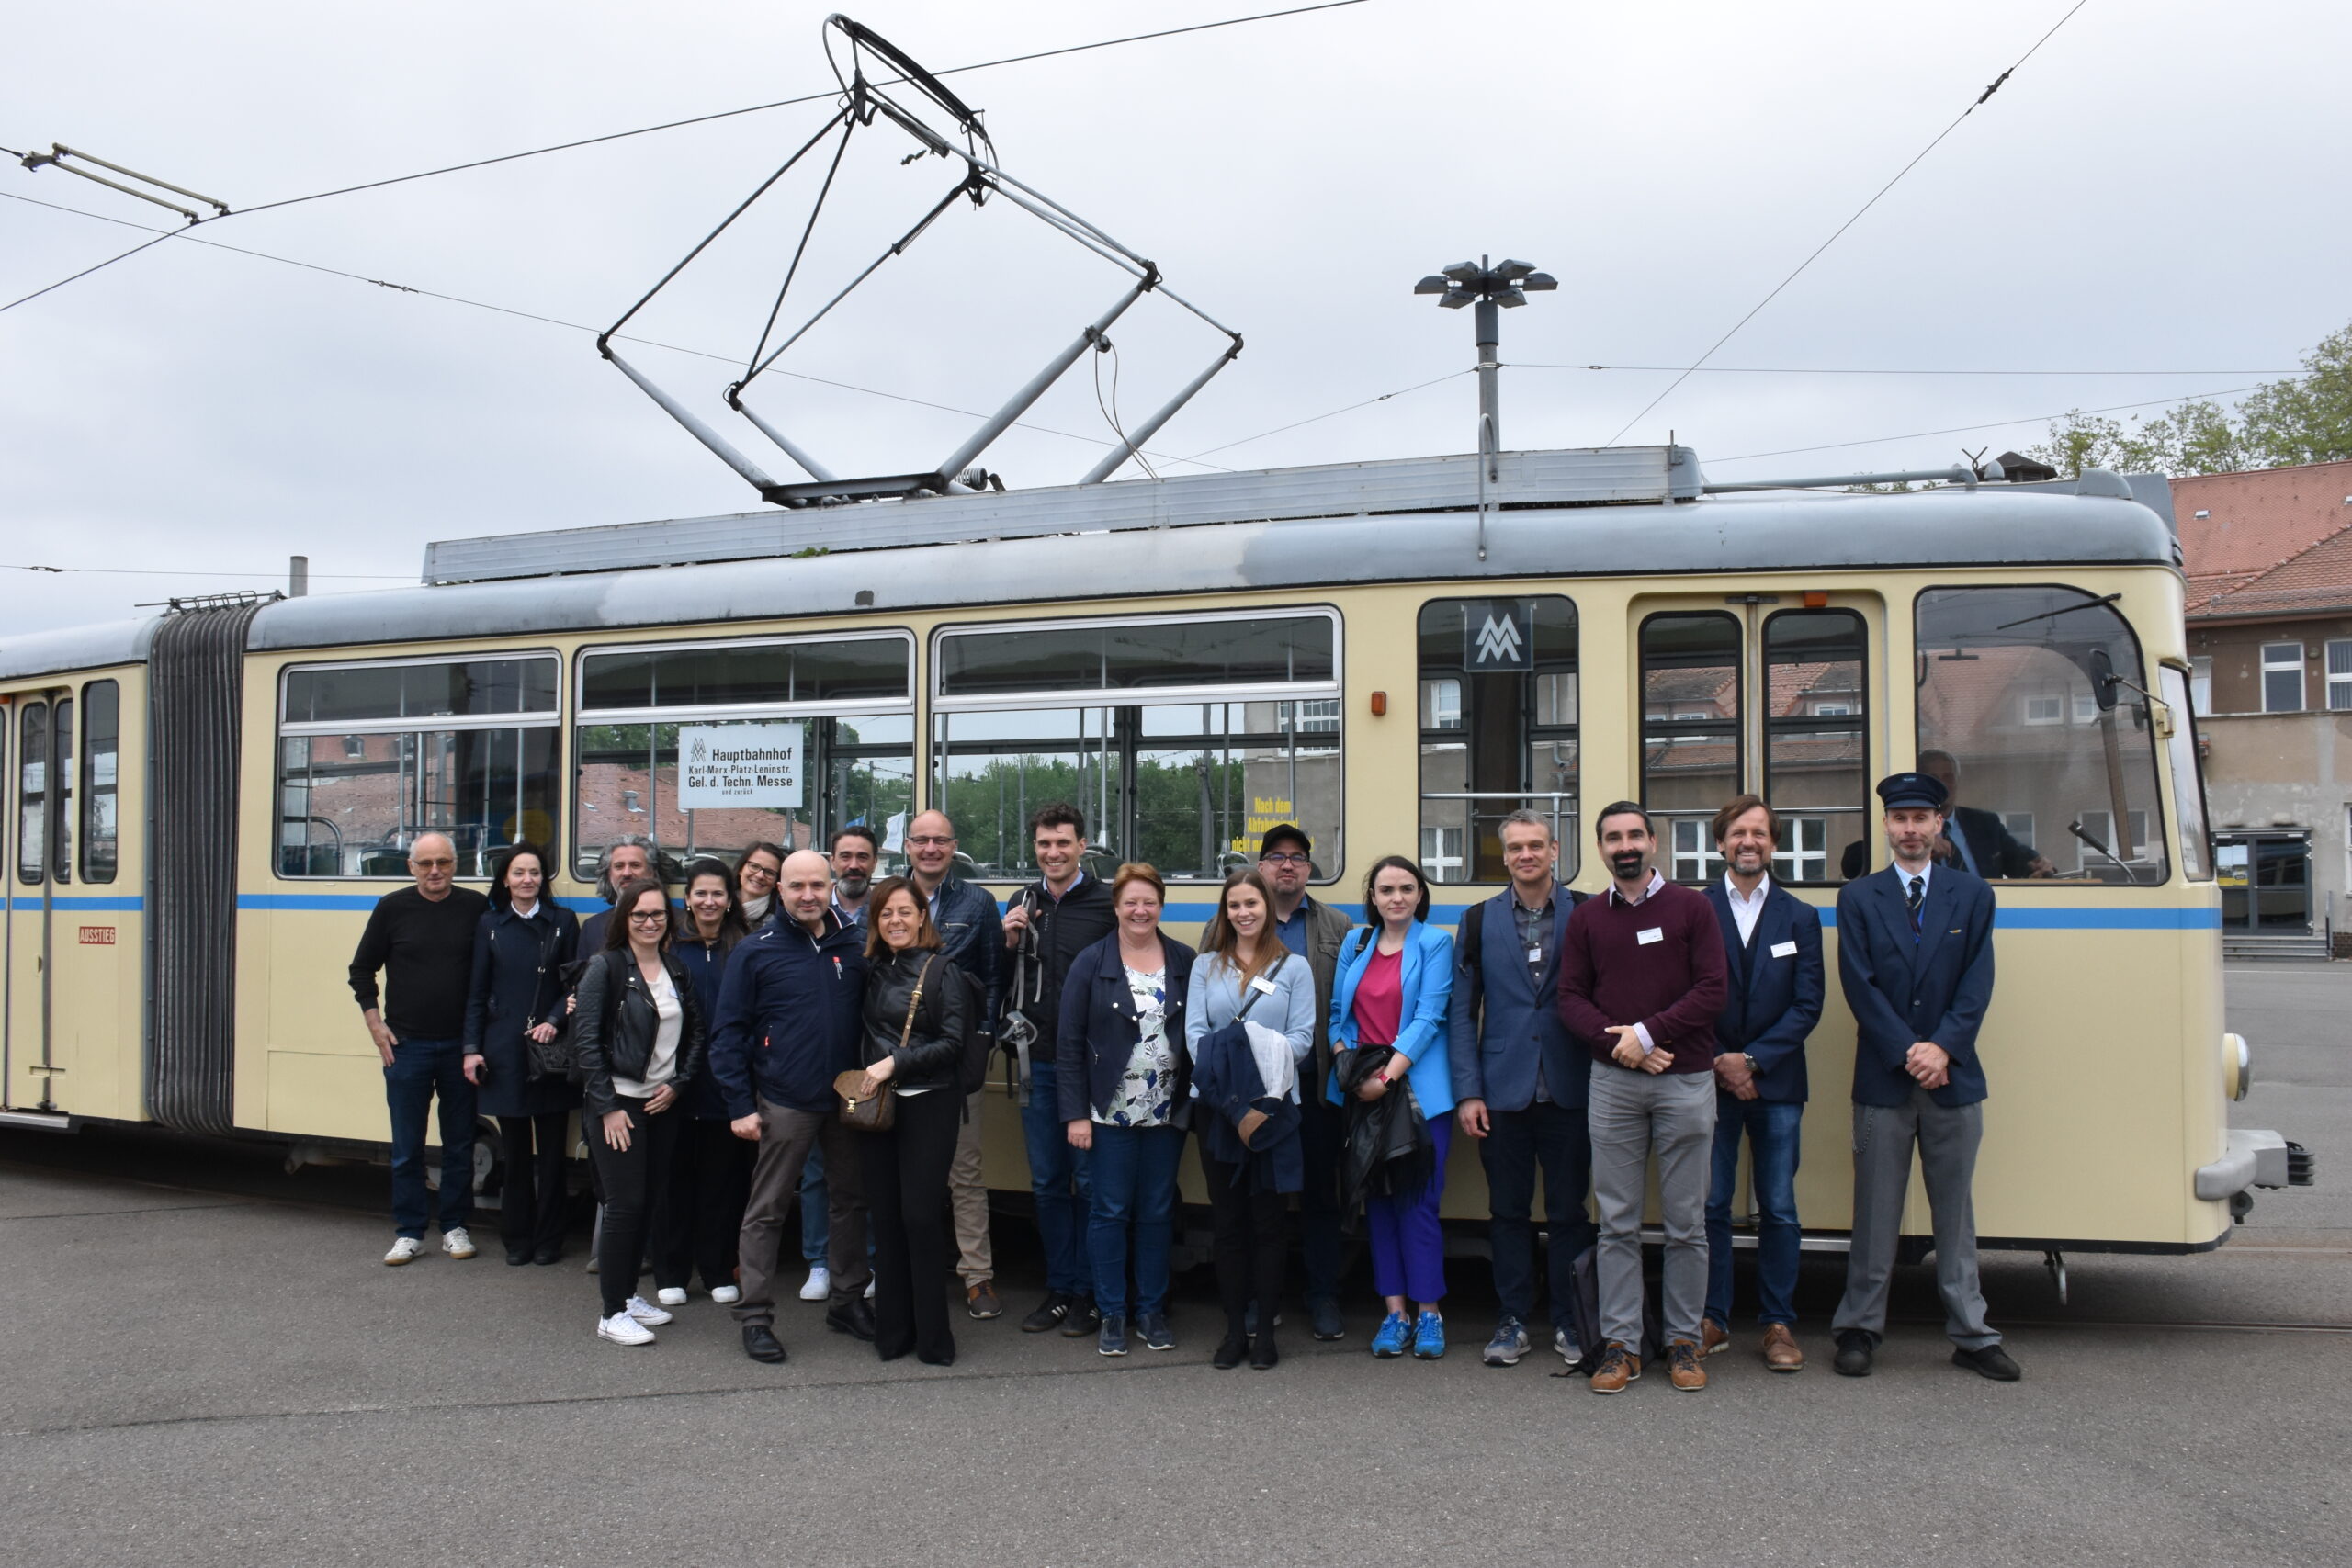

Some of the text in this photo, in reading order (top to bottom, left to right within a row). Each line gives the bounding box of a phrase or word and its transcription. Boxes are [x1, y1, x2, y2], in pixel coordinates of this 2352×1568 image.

[712, 747, 793, 763] Hauptbahnhof
[688, 775, 793, 787] Gel. d. Techn. Messe
[1254, 796, 1291, 813] Nach dem
[1232, 836, 1250, 852] nicht
[80, 928, 115, 942] AUSSTIEG
